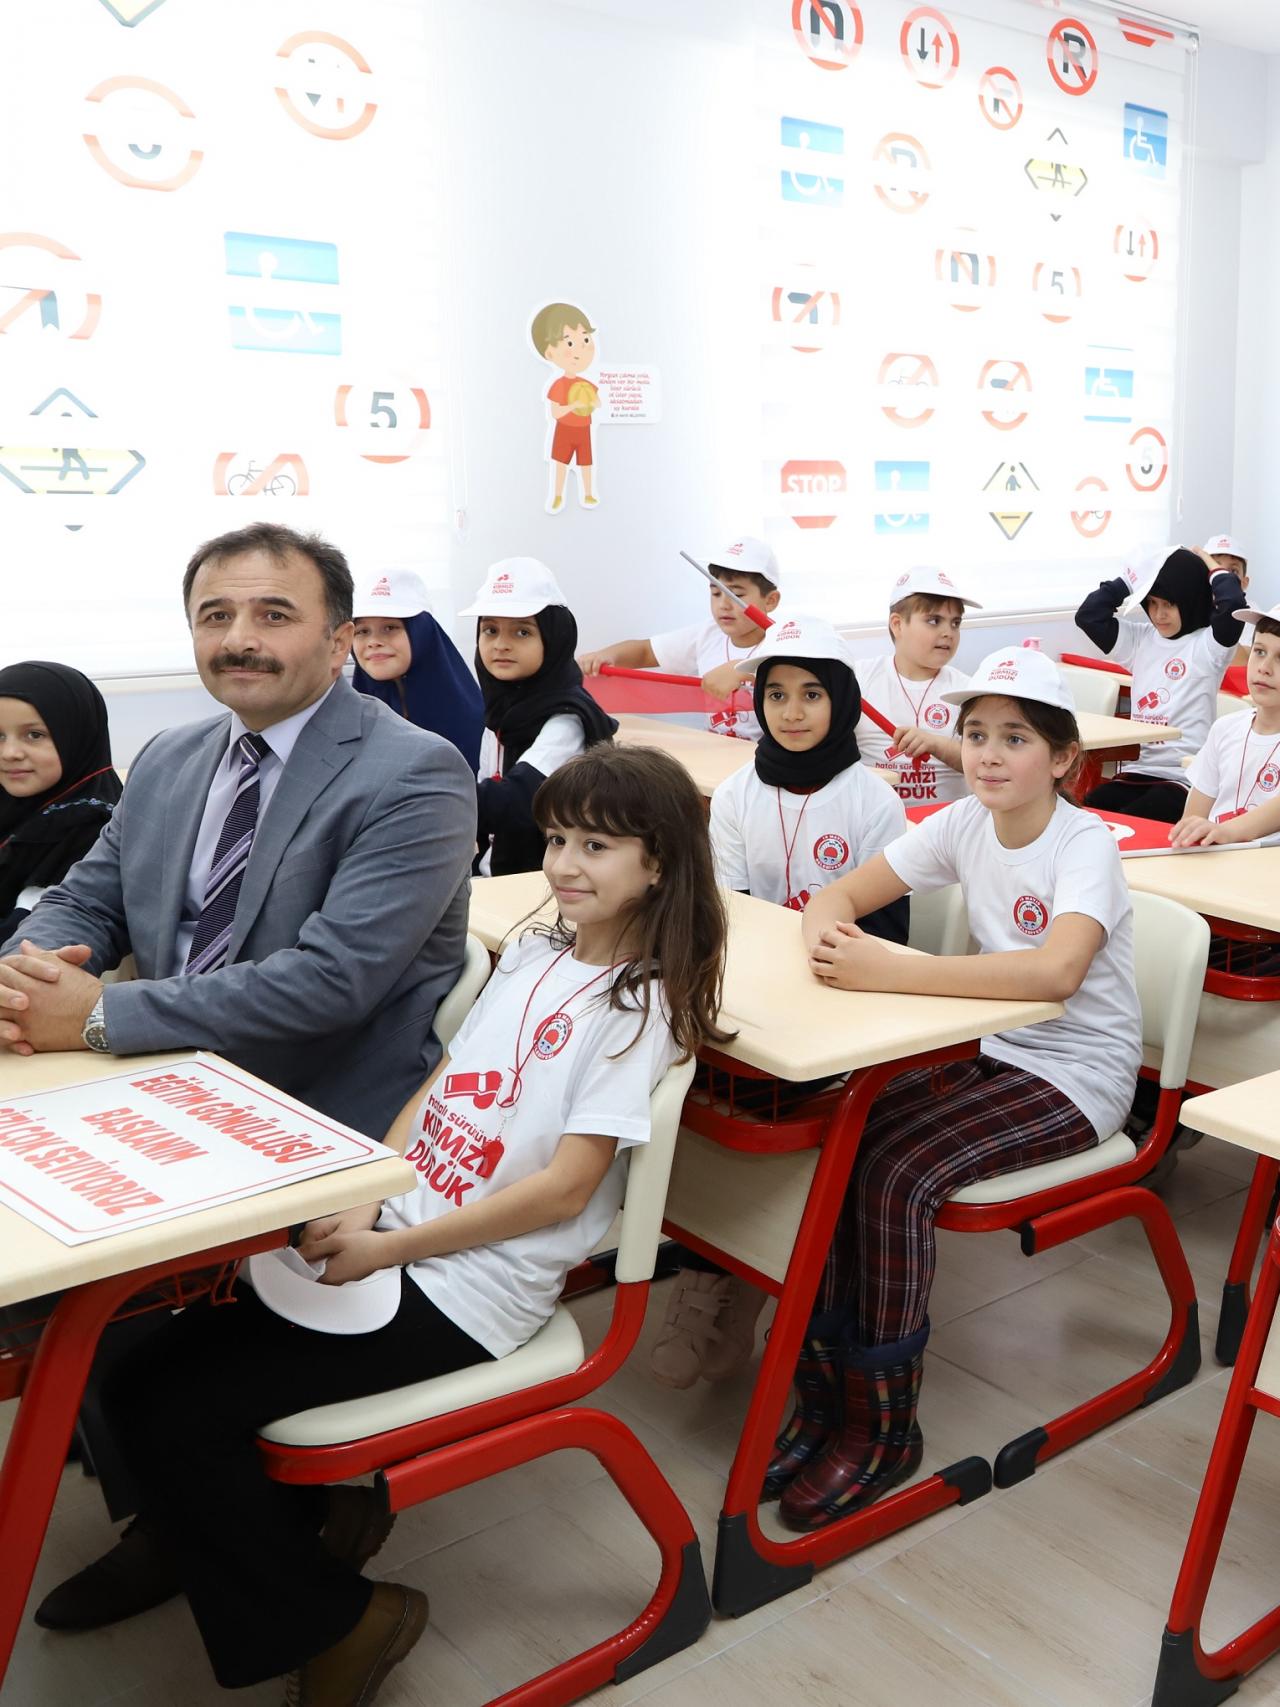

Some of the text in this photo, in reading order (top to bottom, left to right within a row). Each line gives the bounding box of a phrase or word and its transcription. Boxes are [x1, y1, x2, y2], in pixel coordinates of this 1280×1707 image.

[370, 391, 398, 428] 5
[787, 474, 842, 494] STOP
[900, 771, 936, 784] MIZI
[80, 1106, 210, 1166] BAŞKANIM
[129, 1073, 336, 1164] EĞİTİM GÖNÜLLÜSÜ
[23, 1145, 165, 1217] SEVİYORUZ
